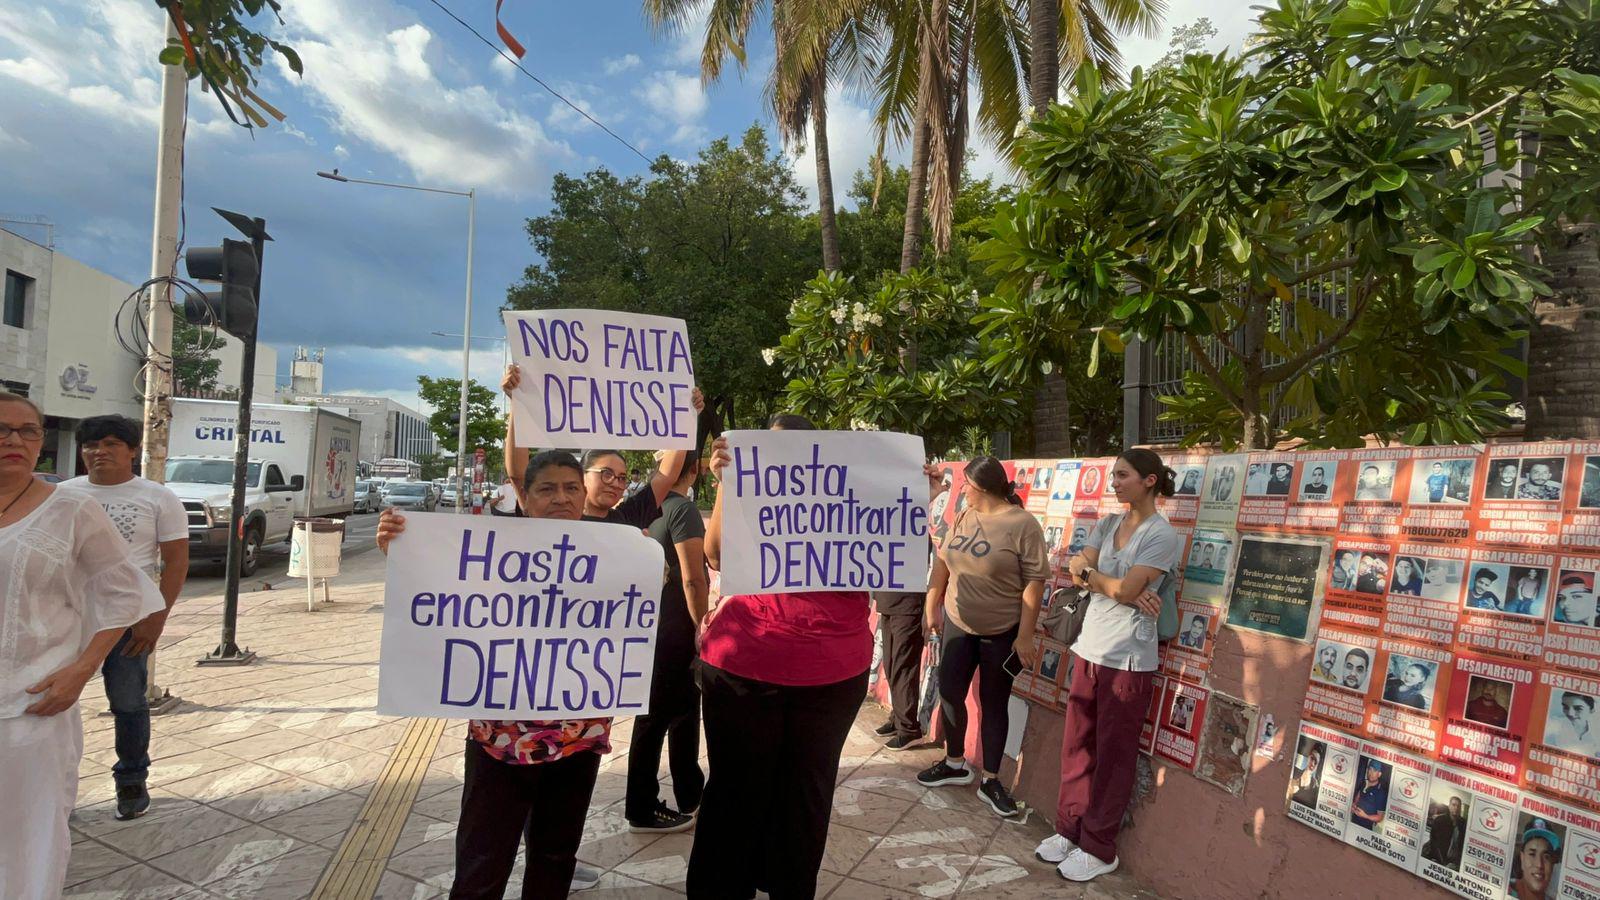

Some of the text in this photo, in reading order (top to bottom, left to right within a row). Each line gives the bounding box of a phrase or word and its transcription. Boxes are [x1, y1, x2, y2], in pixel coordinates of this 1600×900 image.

[517, 319, 693, 376] NOS FALTA
[544, 373, 689, 438] DENISSE
[195, 426, 286, 444] CRITAL
[734, 445, 849, 498] Hasta
[758, 486, 928, 538] encontrarte
[457, 528, 598, 584] Hasta
[760, 541, 905, 589] DENISSE
[1471, 549, 1554, 566] DESAPARECIDO
[410, 584, 656, 629] encontrarte
[1381, 640, 1452, 663] DESAPARECIDO
[1457, 657, 1532, 684] DESAPARECIDO
[440, 637, 649, 712] DENISSE
[1561, 809, 1567, 821] A
[1355, 835, 1406, 862] APOLINAR SOTO
[1370, 835, 1391, 849] PABLO
[1428, 863, 1492, 896] JESUS ANTONIO
